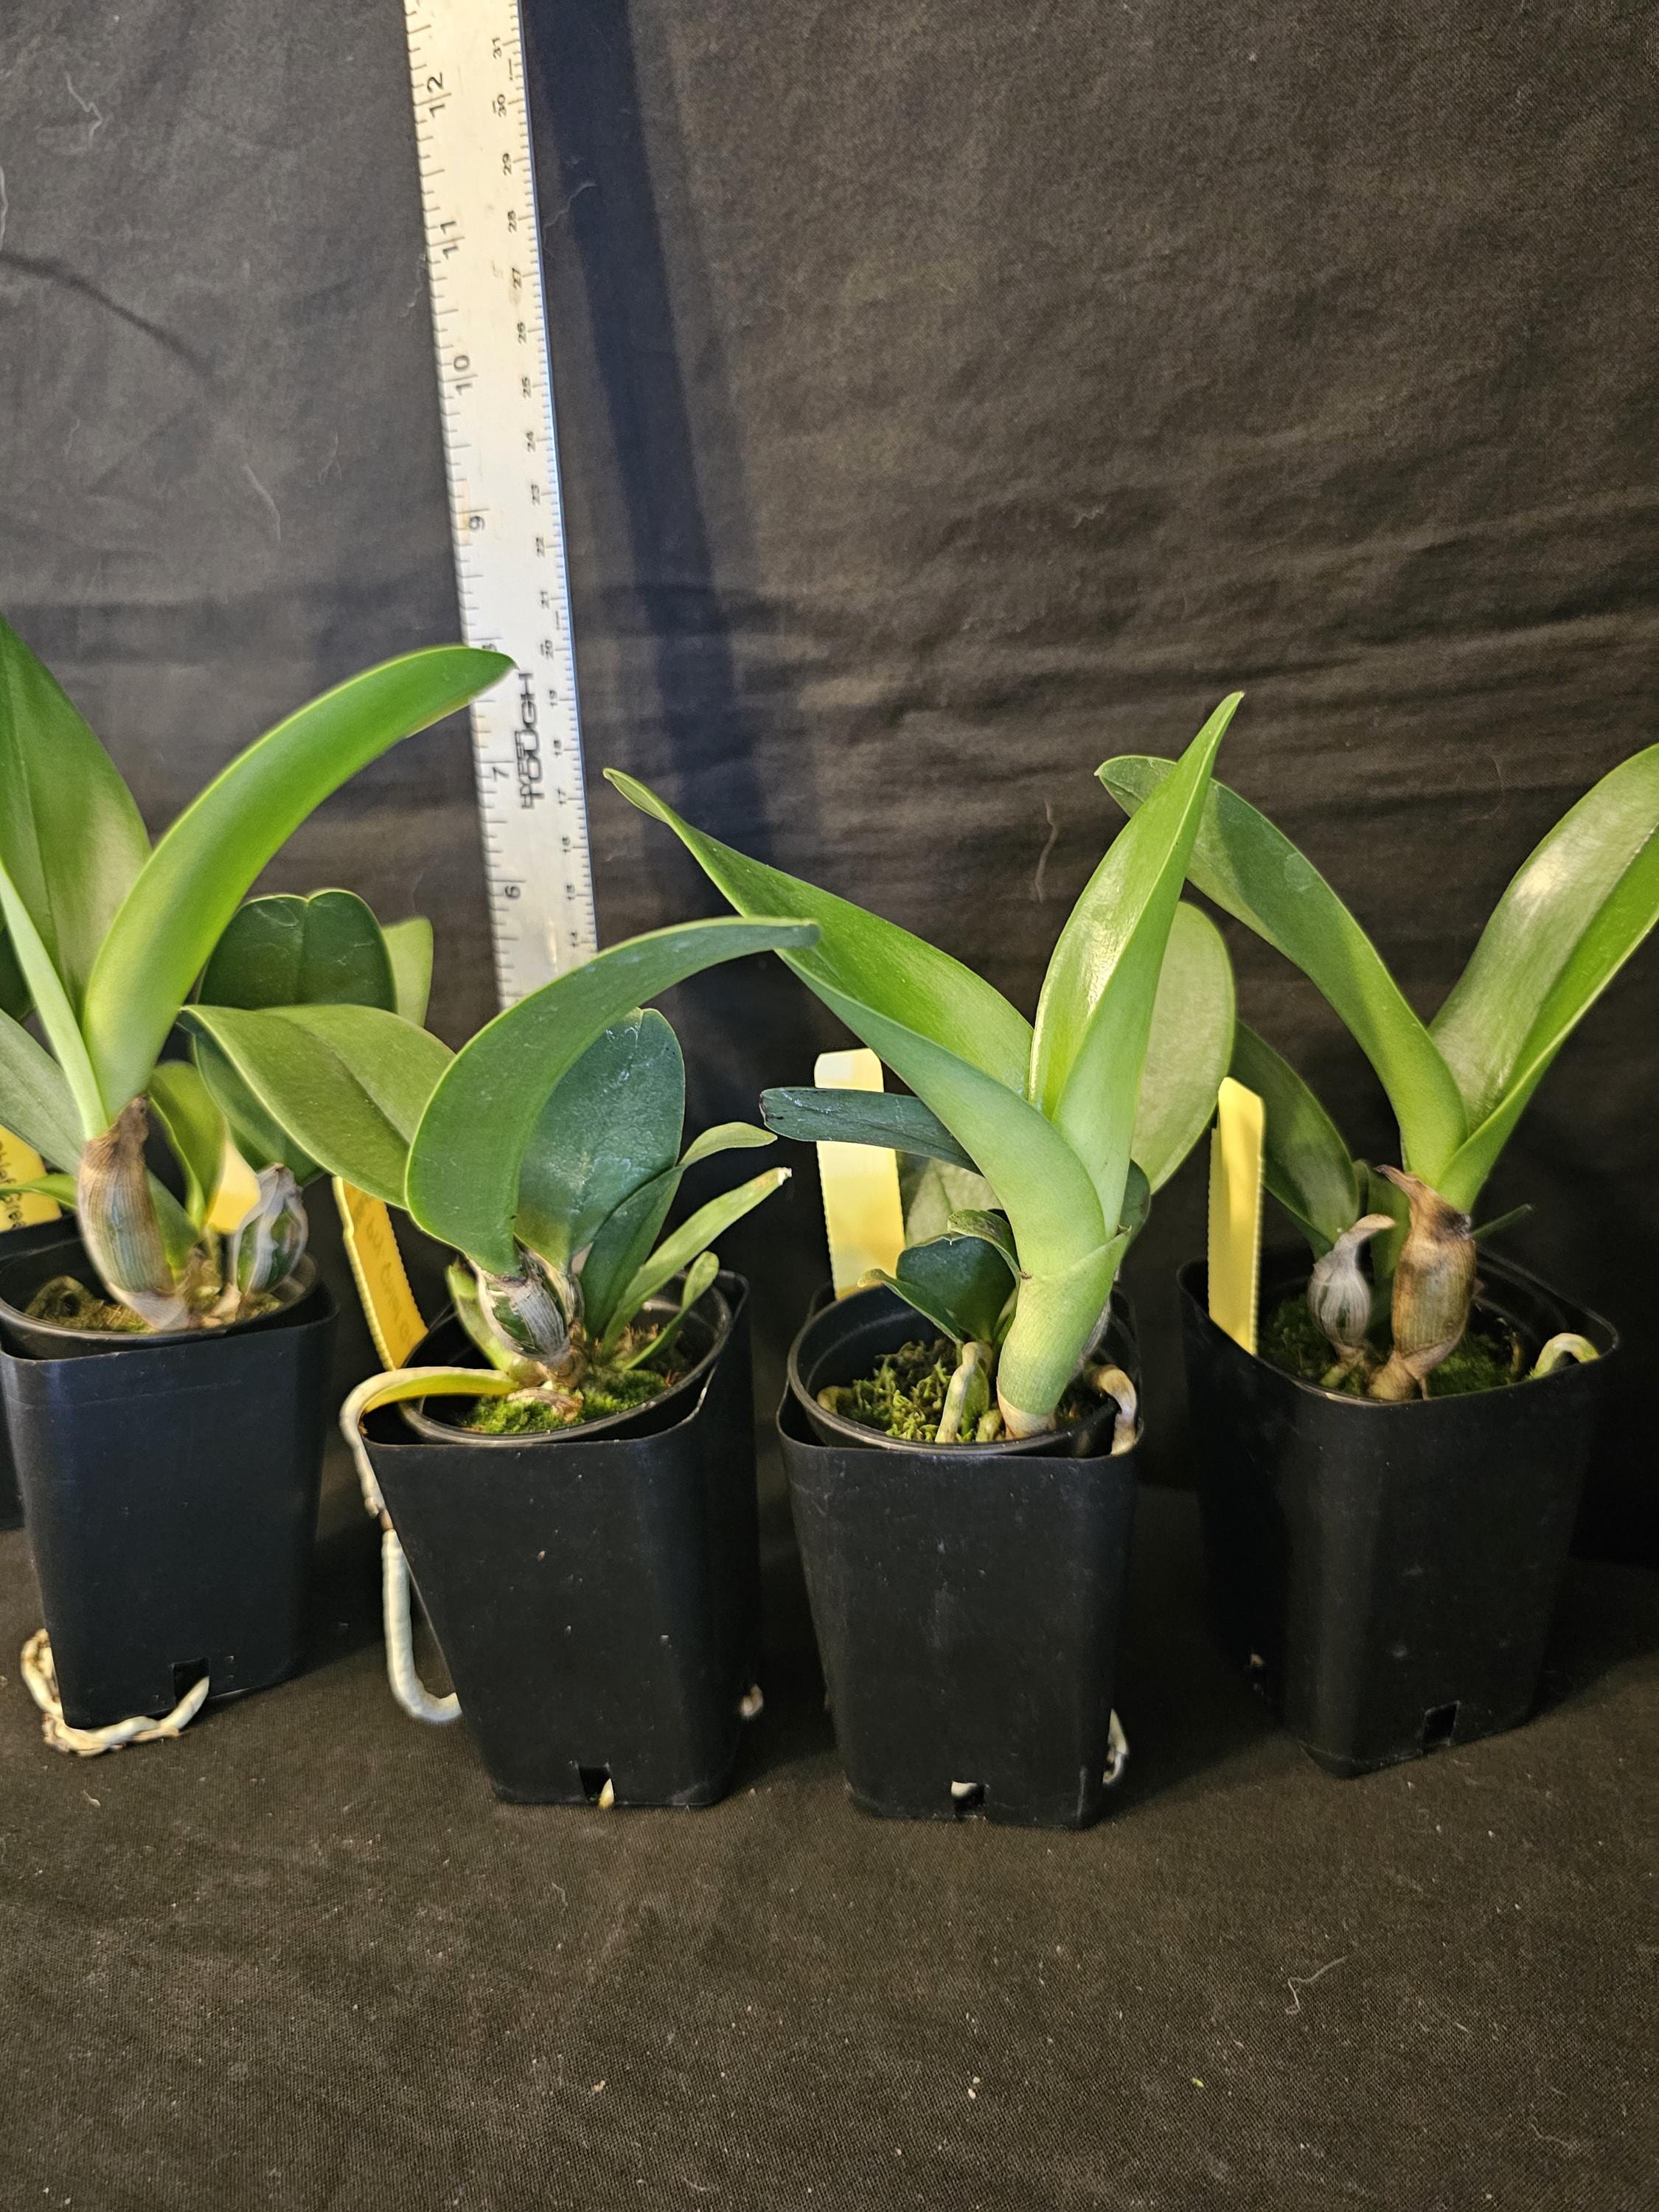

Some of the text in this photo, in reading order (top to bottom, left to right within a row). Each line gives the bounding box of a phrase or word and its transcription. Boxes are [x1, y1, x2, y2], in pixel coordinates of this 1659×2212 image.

[427, 72, 445, 119] 12
[496, 94, 507, 118] 30
[502, 153, 512, 176] 29
[507, 209, 518, 234] 28
[439, 220, 459, 260] 11
[511, 267, 522, 290] 27
[517, 321, 527, 345] 26
[453, 355, 473, 396] 10
[521, 376, 532, 399] 25
[526, 431, 537, 453] 24
[531, 483, 540, 507] 23
[468, 515, 485, 531] 9
[535, 537, 546, 559] 22
[540, 591, 550, 610] 21
[545, 639, 554, 659] 20
[549, 690, 558, 706] 19
[518, 672, 544, 801] TOUGH
[493, 766, 509, 782] 7
[505, 886, 521, 899] 6
